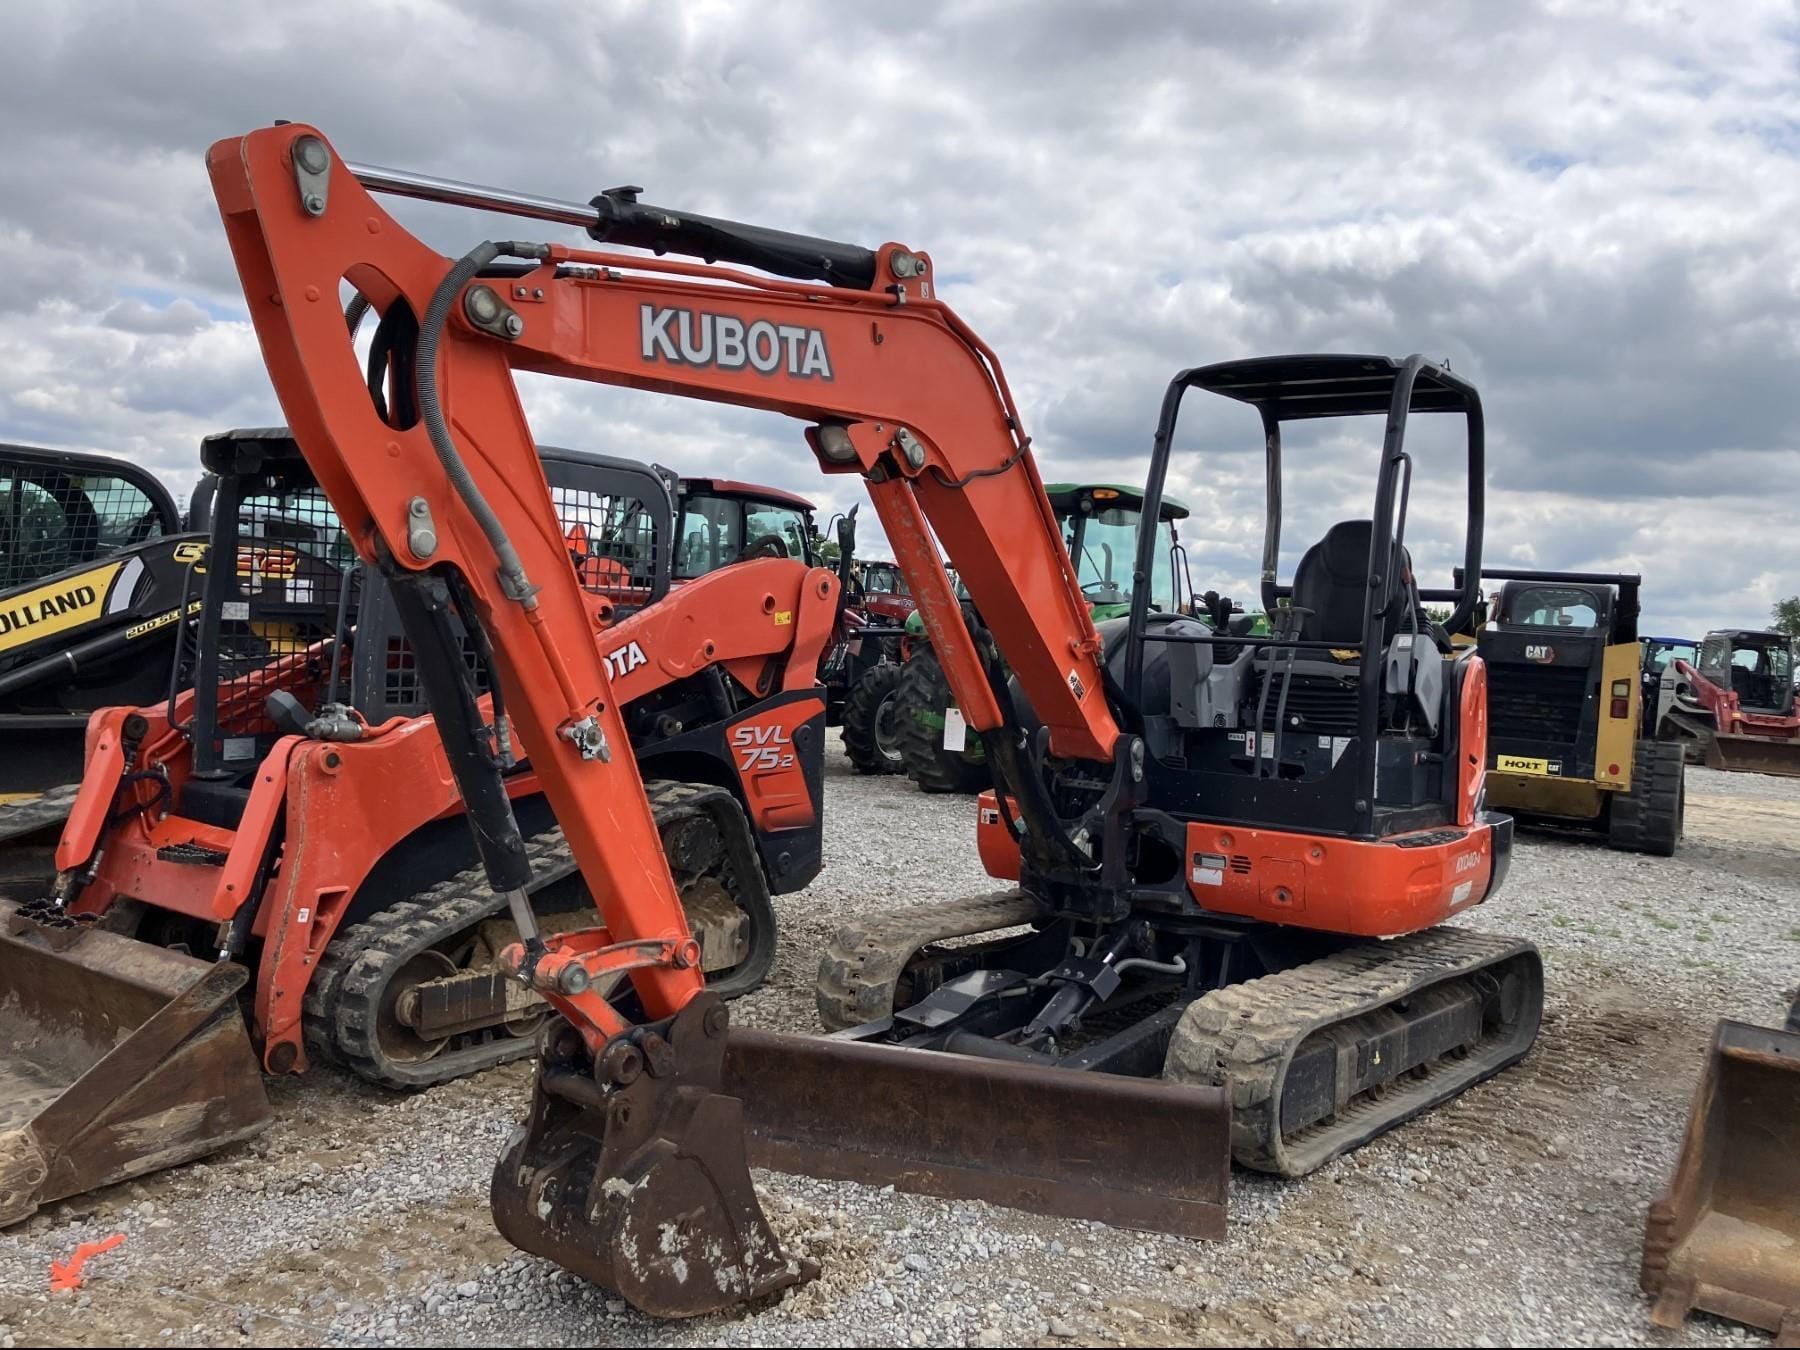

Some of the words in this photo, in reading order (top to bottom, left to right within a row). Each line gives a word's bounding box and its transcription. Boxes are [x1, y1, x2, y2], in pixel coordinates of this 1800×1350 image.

[640, 304, 832, 378] KUBOTA
[1525, 644, 1548, 659] CAT
[731, 725, 790, 747] SVL
[740, 746, 794, 771] 75-2
[1505, 759, 1542, 770] HOLT
